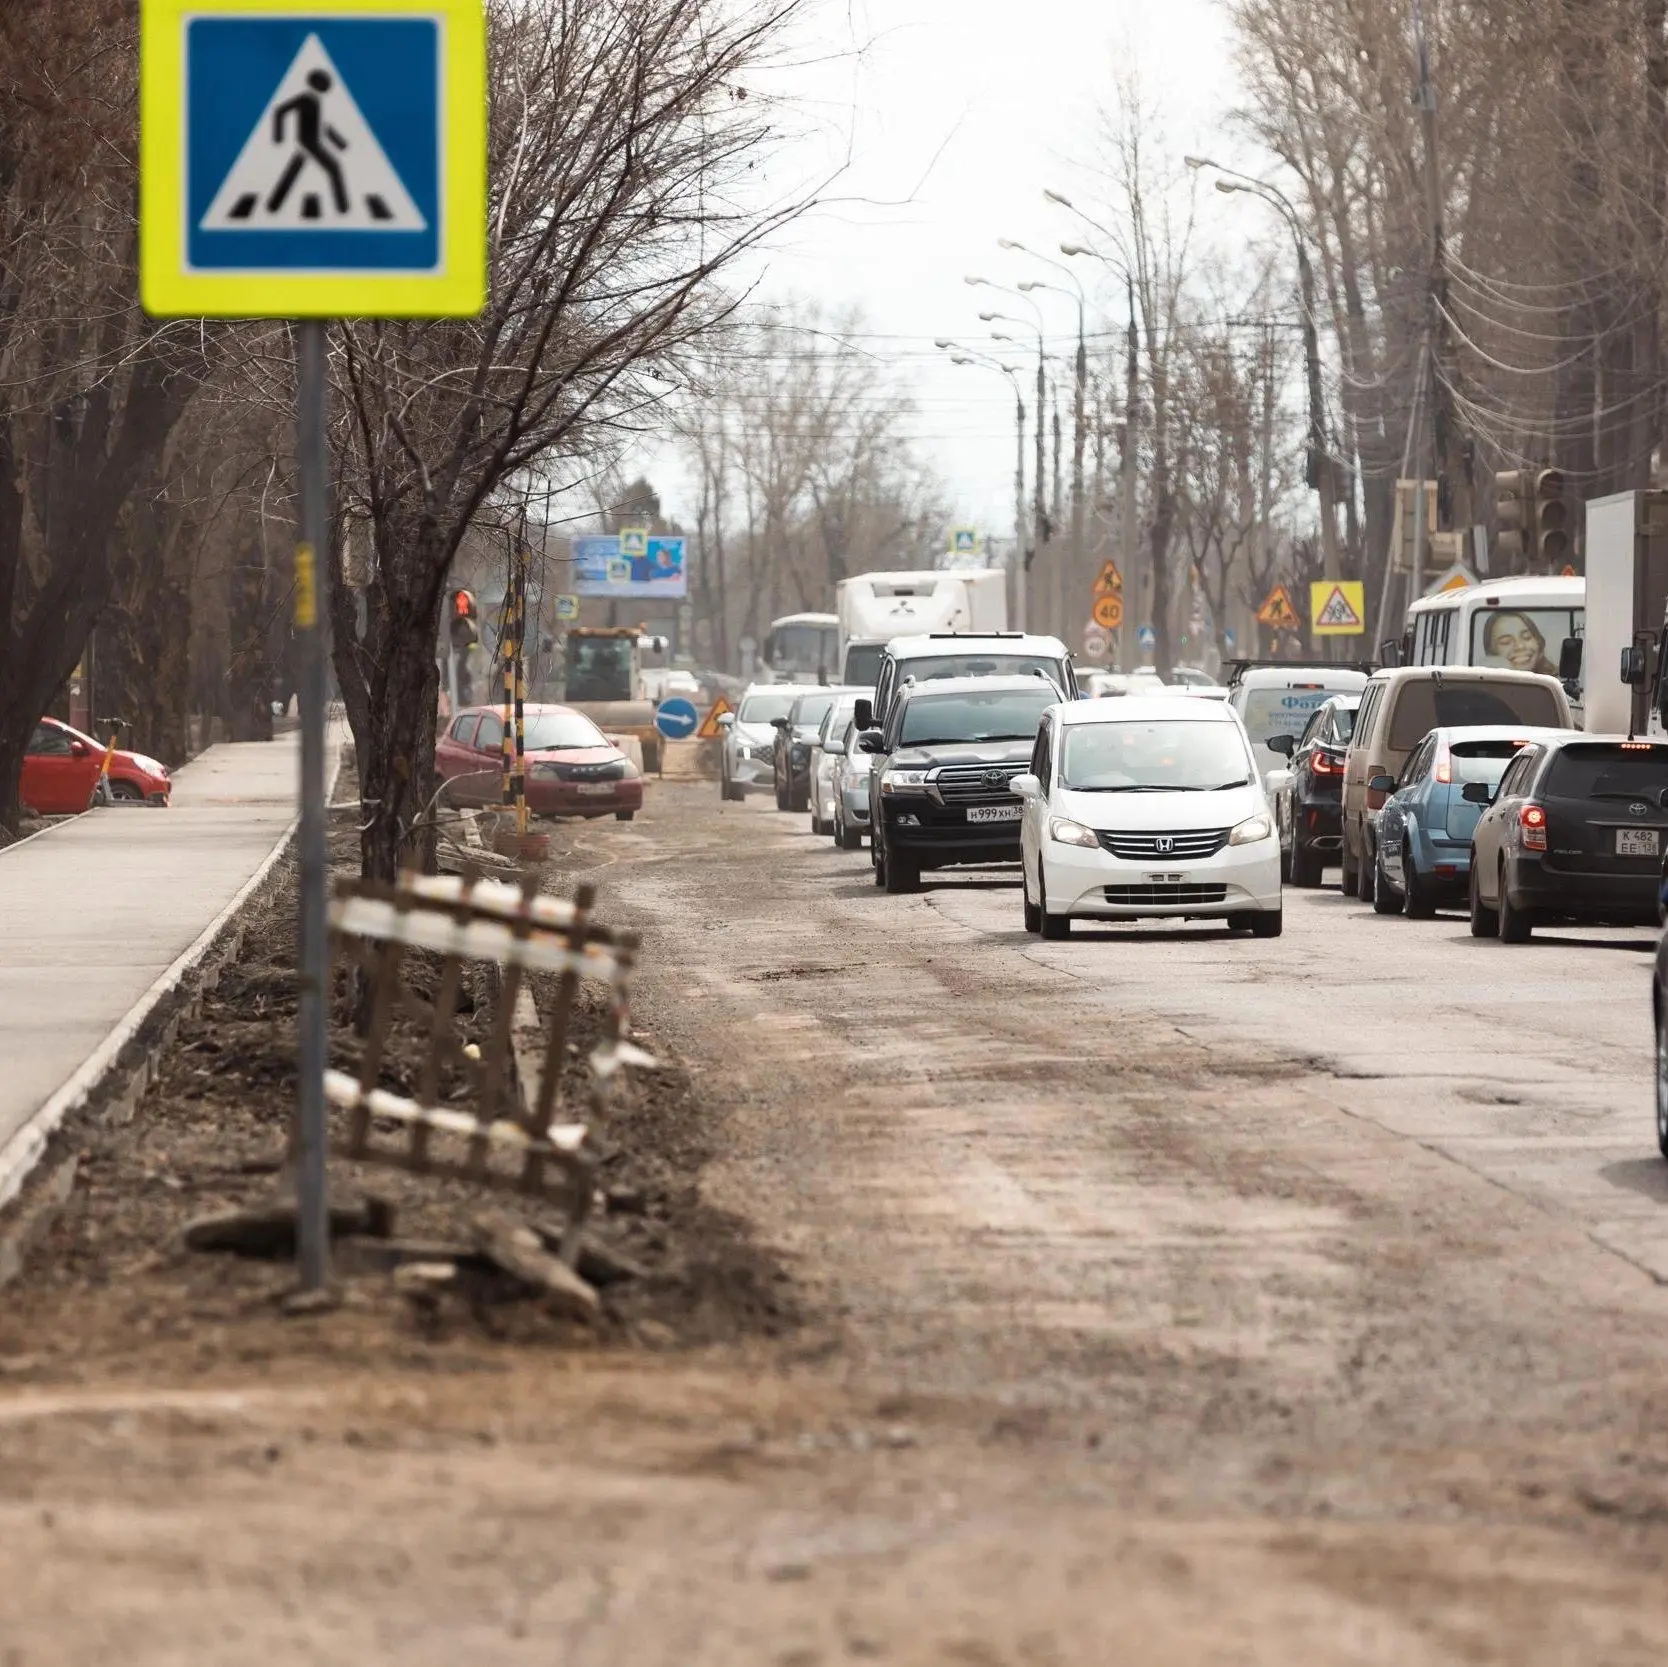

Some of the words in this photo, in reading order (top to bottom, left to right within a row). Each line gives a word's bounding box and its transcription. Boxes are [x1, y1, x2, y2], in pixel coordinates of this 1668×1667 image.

[1101, 605, 1119, 619] 40
[1634, 831, 1653, 842] 482
[1621, 843, 1638, 854] ЕЕ
